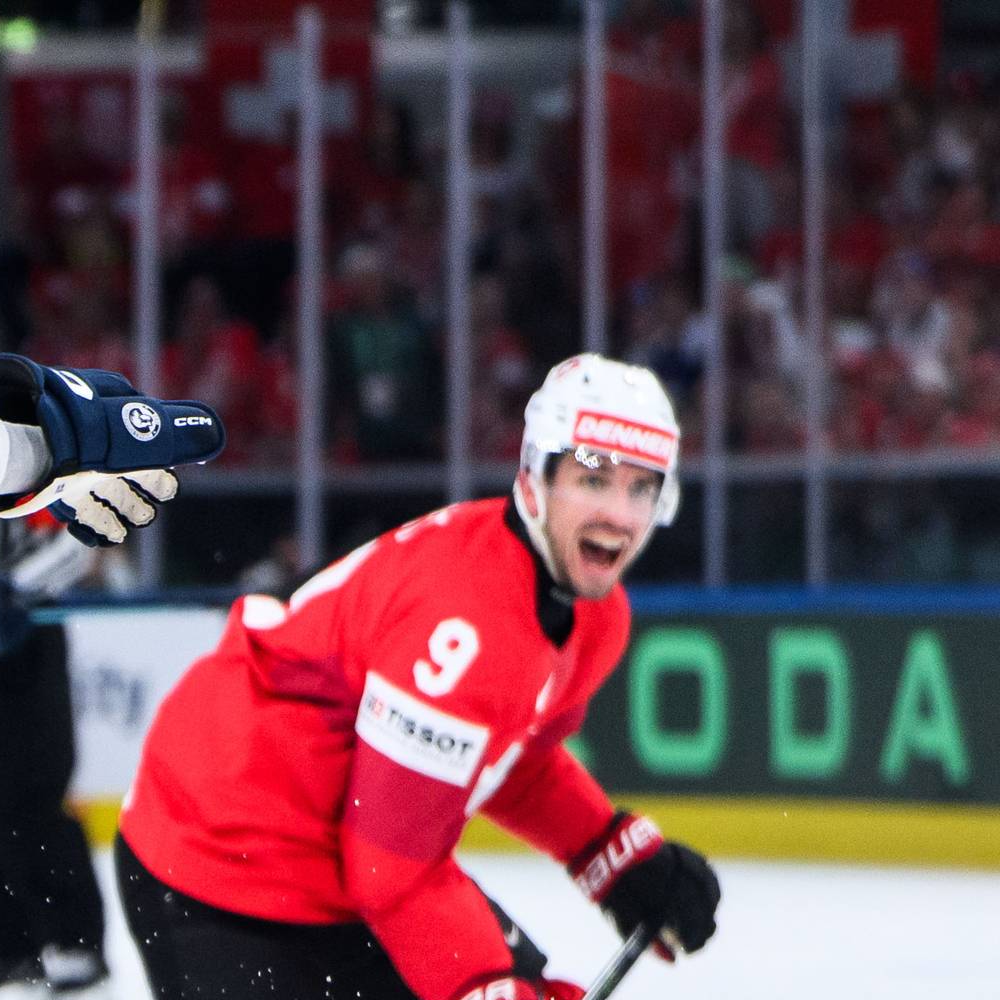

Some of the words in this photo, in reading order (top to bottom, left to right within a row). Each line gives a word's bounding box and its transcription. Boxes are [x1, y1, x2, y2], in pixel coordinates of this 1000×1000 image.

[174, 416, 213, 427] CCM
[412, 617, 480, 697] 9
[563, 627, 971, 784] ODA
